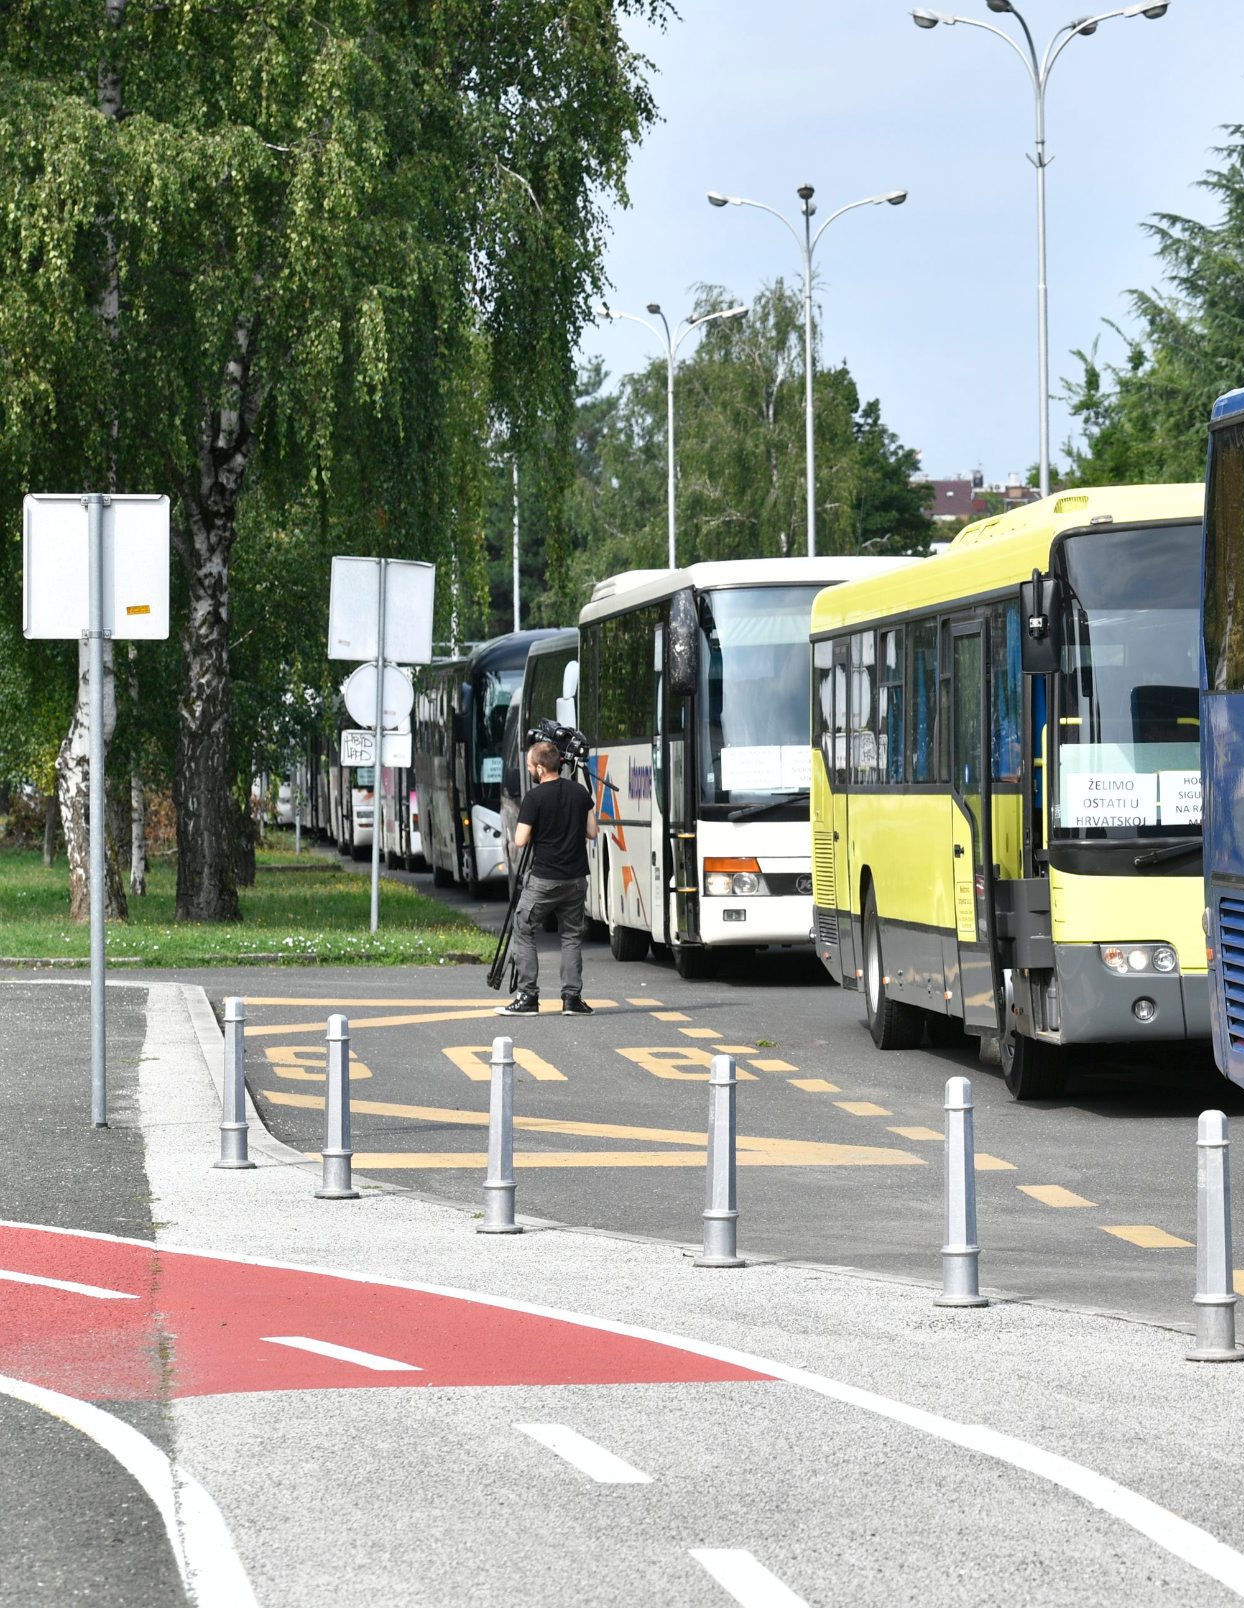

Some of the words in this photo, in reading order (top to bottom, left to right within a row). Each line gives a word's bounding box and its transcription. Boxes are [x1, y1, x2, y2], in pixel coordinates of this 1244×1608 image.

[1088, 778, 1135, 791] ŽELIMO
[1083, 798, 1127, 809] OSTATI
[1130, 798, 1139, 809] U
[1175, 805, 1190, 814] NA
[1076, 816, 1147, 827] HRVATSKOJ
